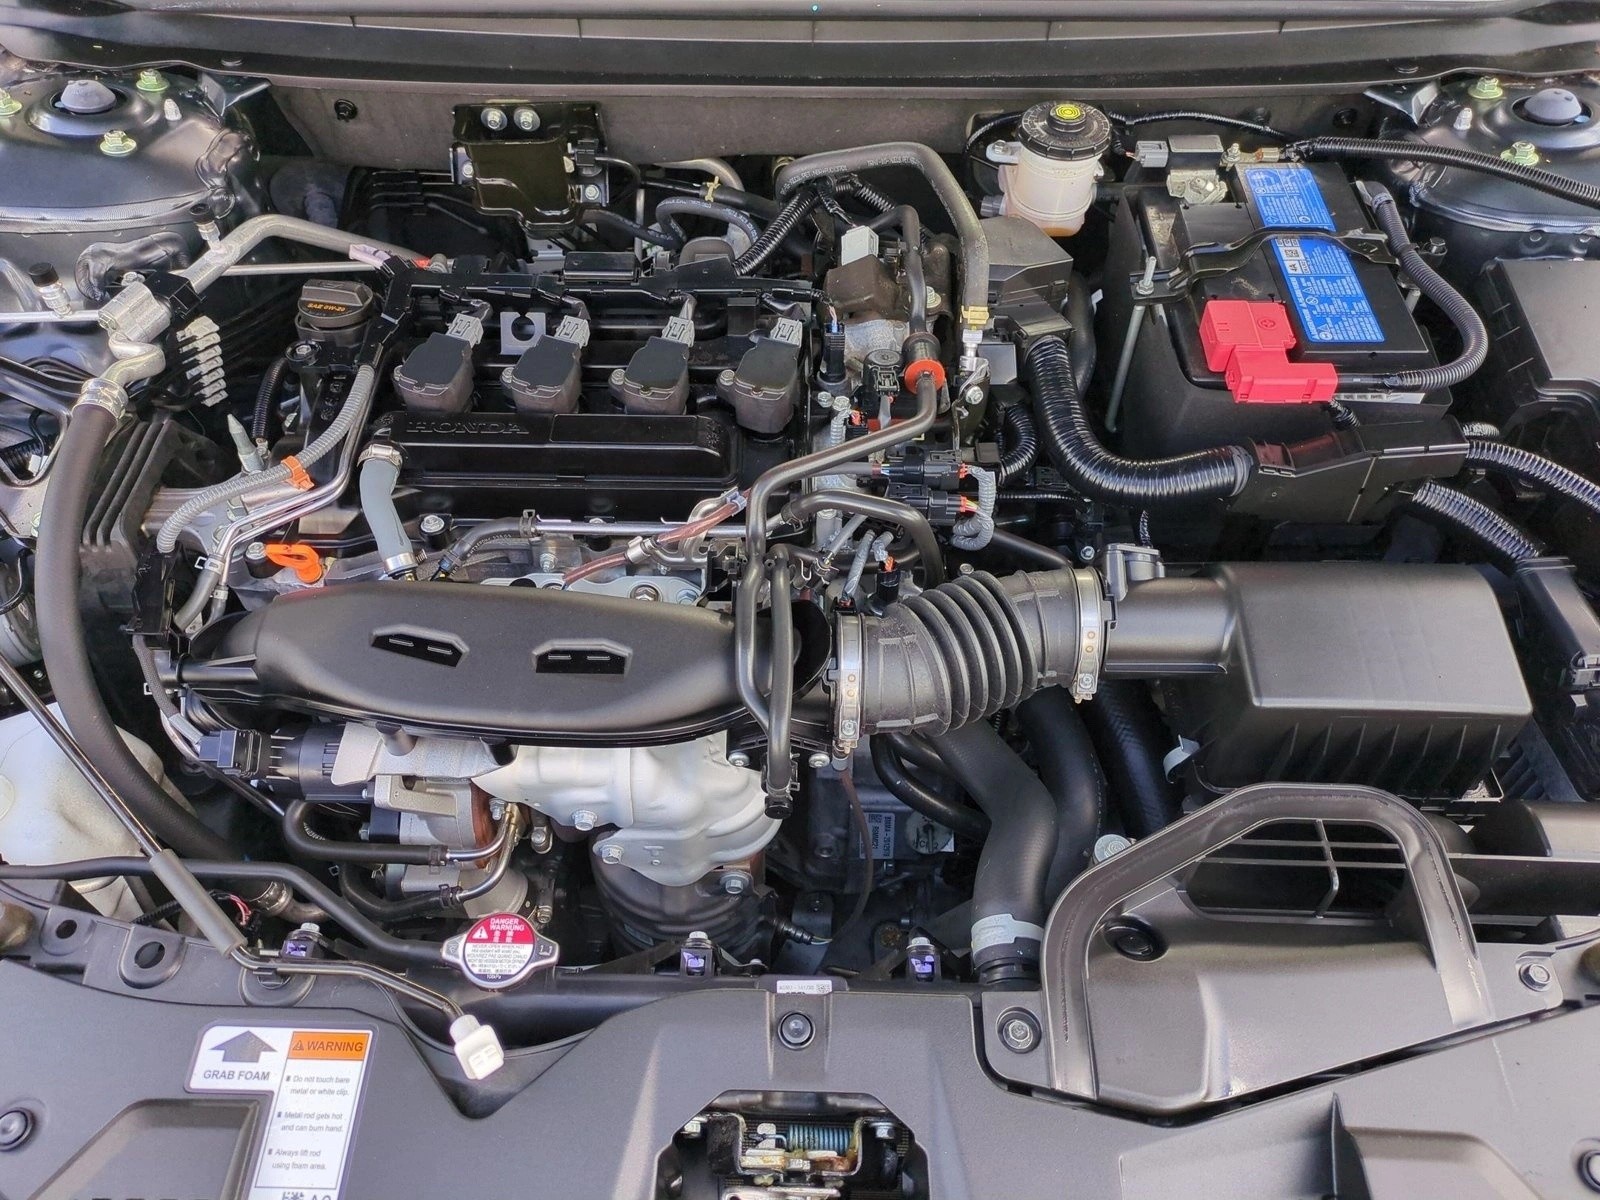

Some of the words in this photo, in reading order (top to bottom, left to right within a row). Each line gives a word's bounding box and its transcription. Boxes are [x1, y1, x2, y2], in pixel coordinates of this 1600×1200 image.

[307, 302, 323, 310] SAE
[323, 304, 346, 312] 0W-20
[406, 422, 530, 434] HONDA
[307, 1041, 363, 1052] WARNING
[203, 1070, 235, 1081] GRAB
[237, 1071, 270, 1082] FOAM
[335, 1076, 351, 1084] bare
[275, 1149, 299, 1158] Always
[300, 1149, 308, 1157] lift
[272, 1161, 290, 1170] using
